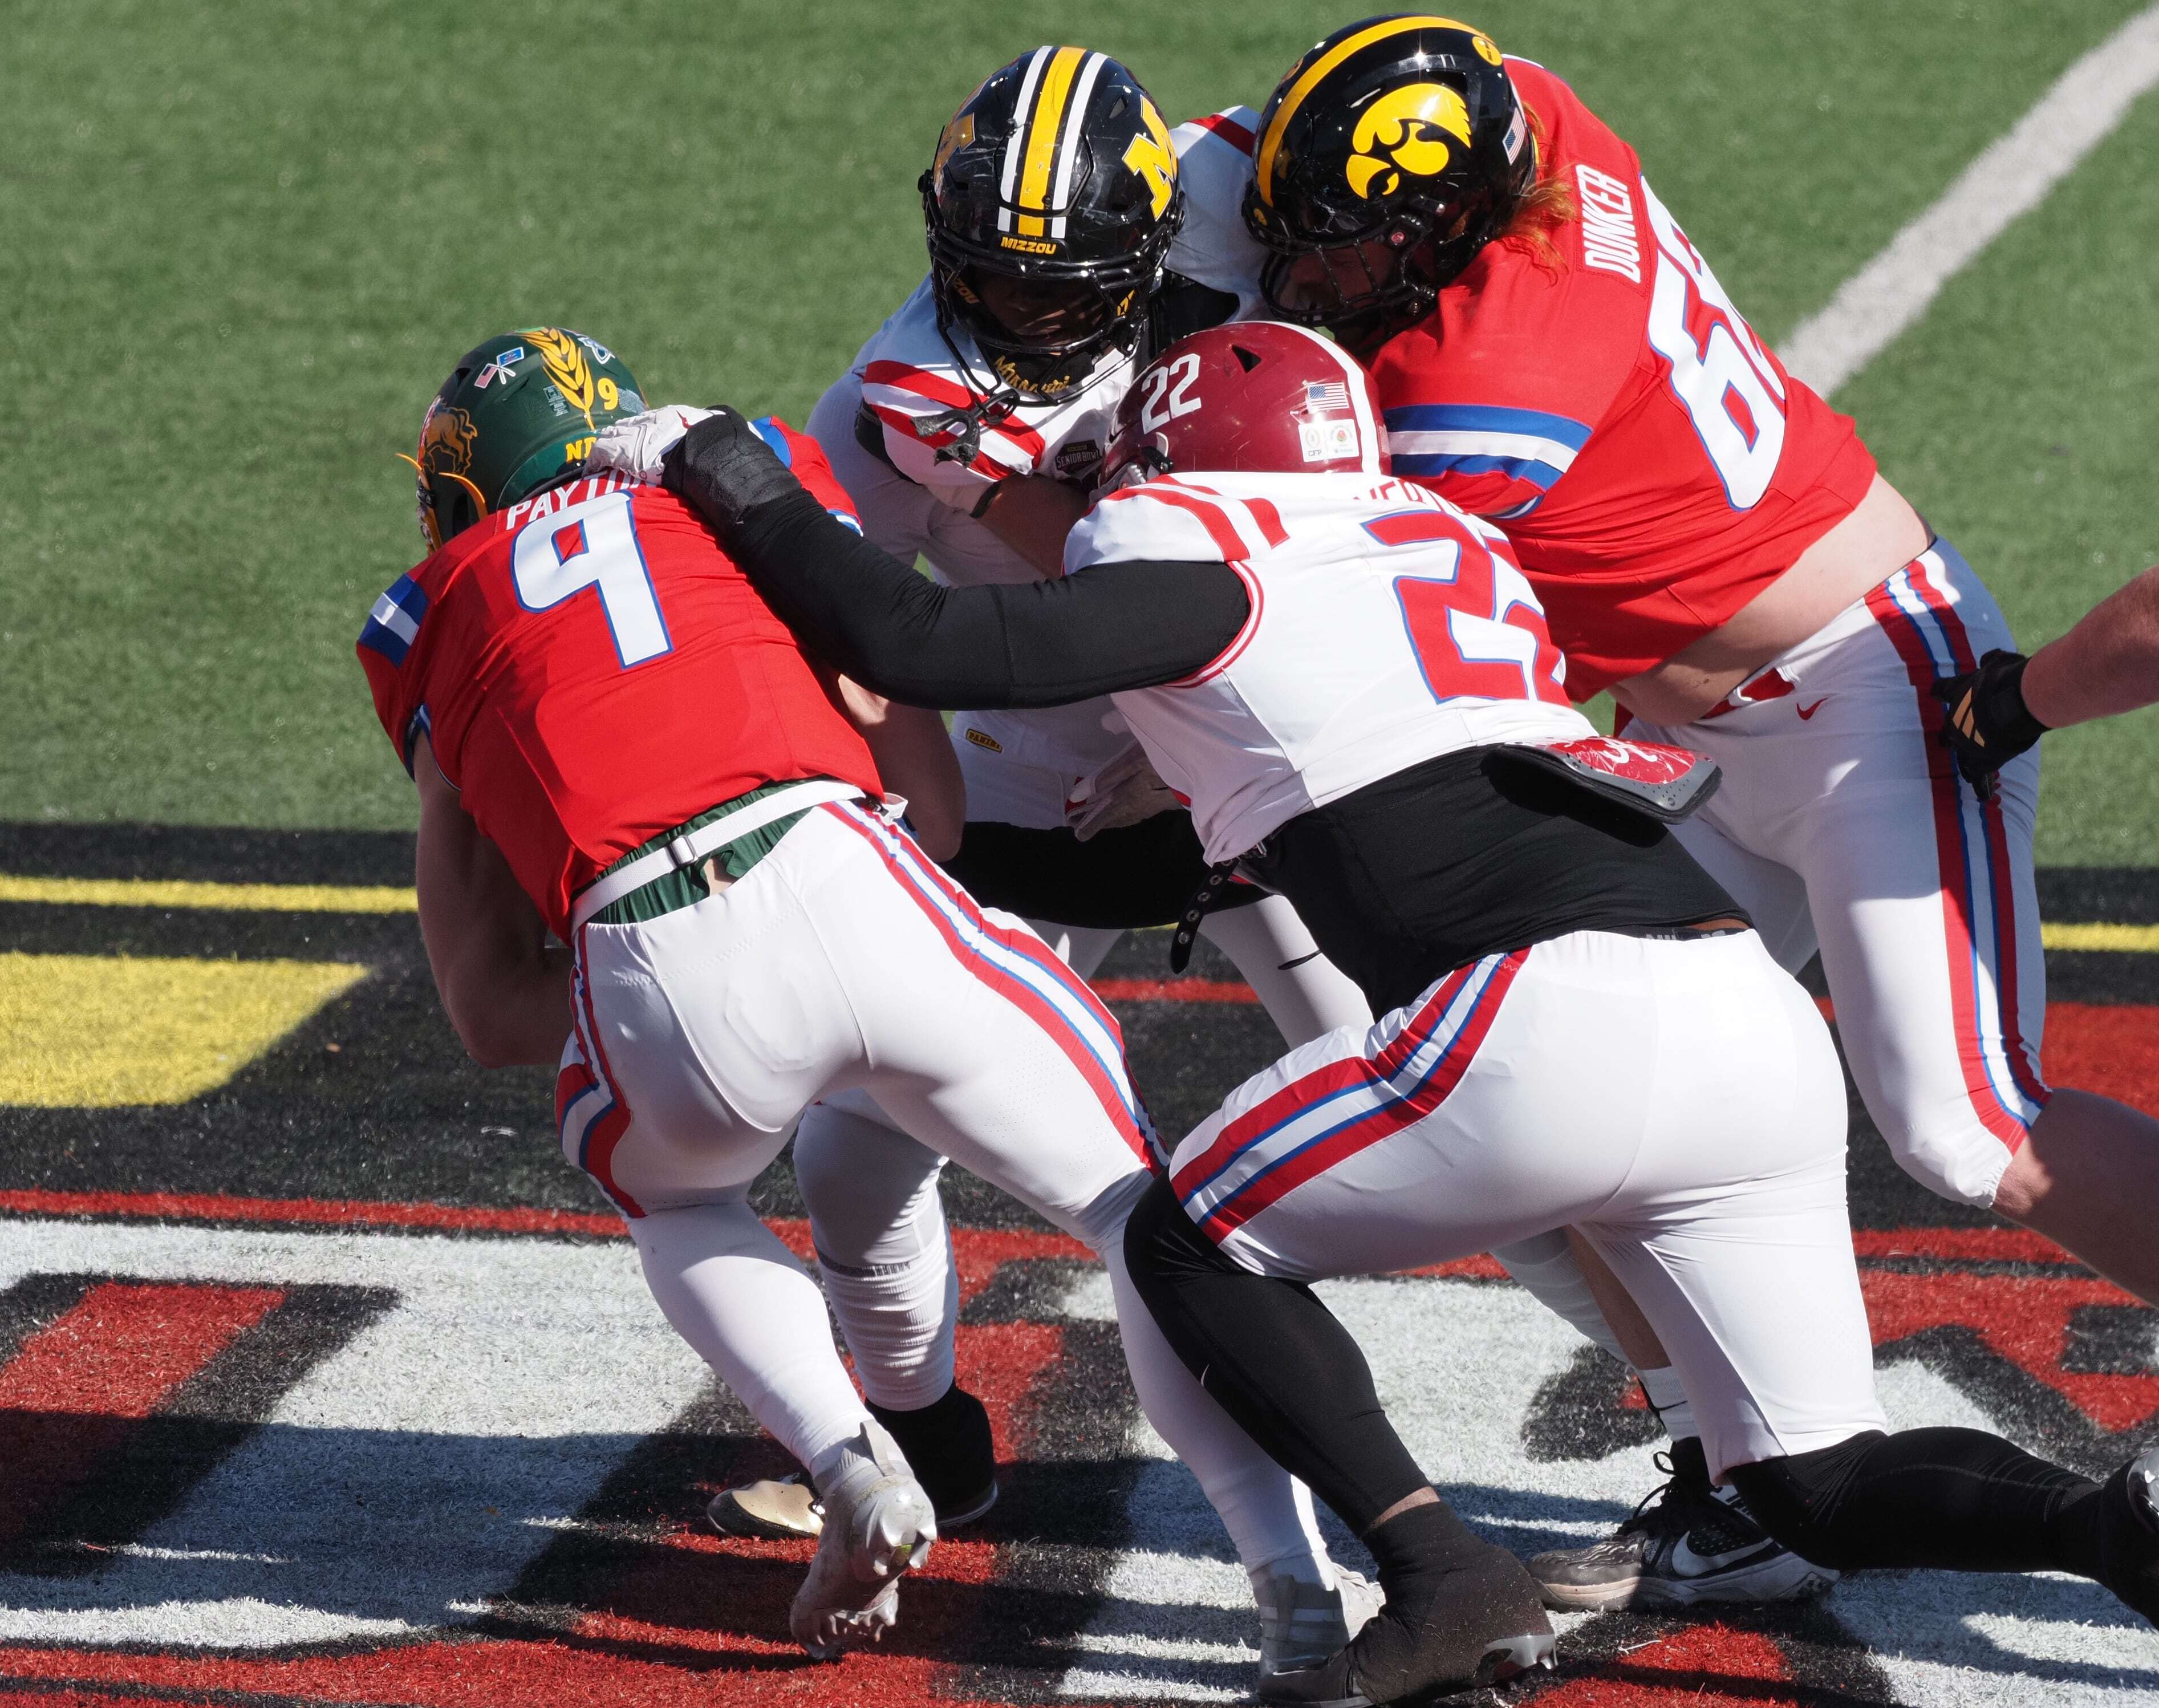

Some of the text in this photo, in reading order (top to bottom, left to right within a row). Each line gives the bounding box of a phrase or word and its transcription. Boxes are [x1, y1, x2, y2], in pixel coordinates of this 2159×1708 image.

[1000, 236, 1057, 254] MIZZOU
[1575, 164, 1641, 283] DUNKER
[1639, 173, 1786, 512] 69
[597, 378, 618, 410] 9
[1141, 353, 1201, 435] 22
[510, 489, 675, 669] 9
